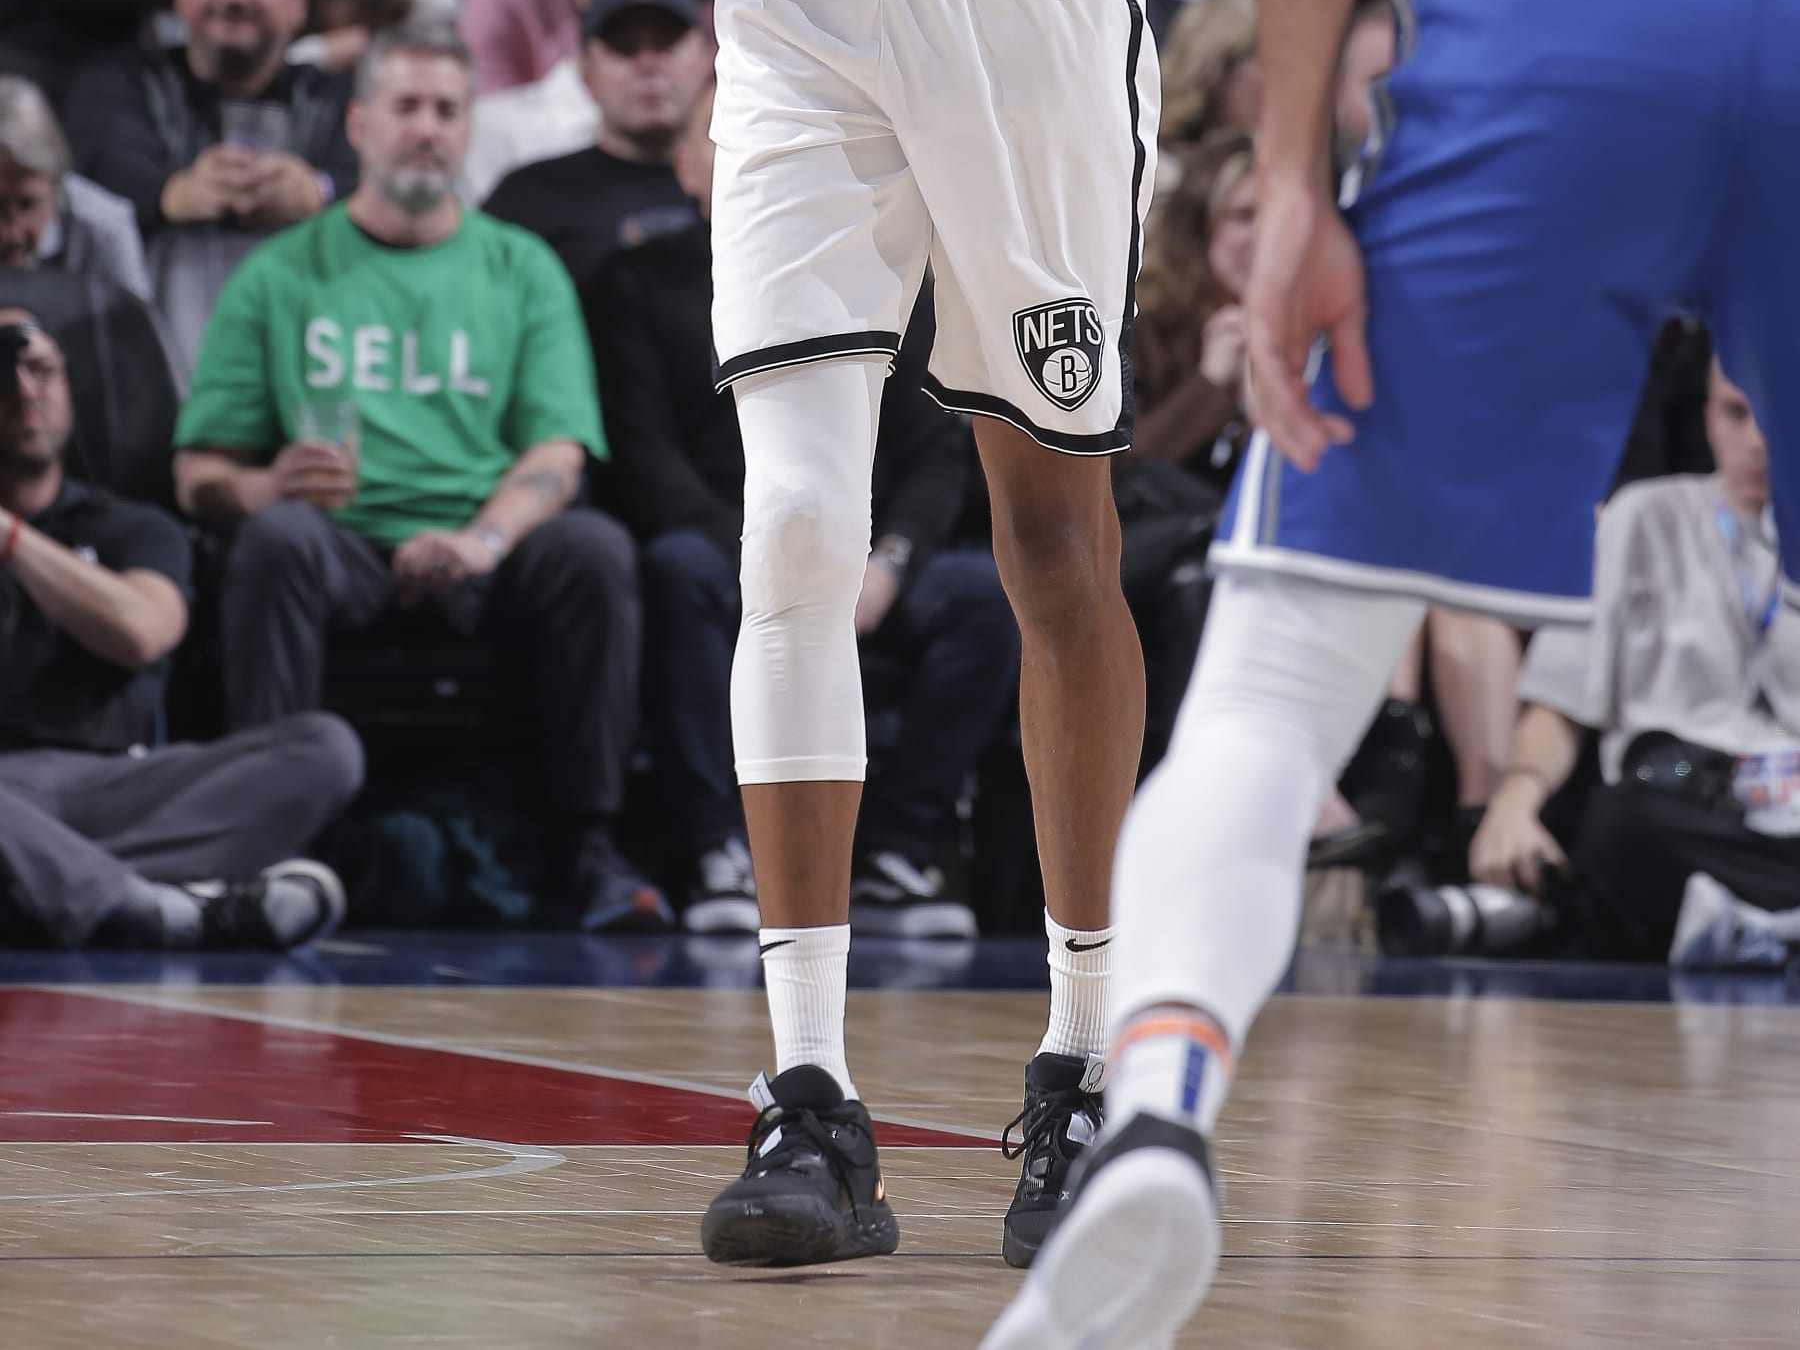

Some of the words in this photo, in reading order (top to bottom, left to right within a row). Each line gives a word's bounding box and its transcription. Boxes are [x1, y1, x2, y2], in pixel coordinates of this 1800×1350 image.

[1023, 305, 1102, 354] NETS
[304, 316, 492, 398] SELL
[1060, 354, 1077, 393] B
